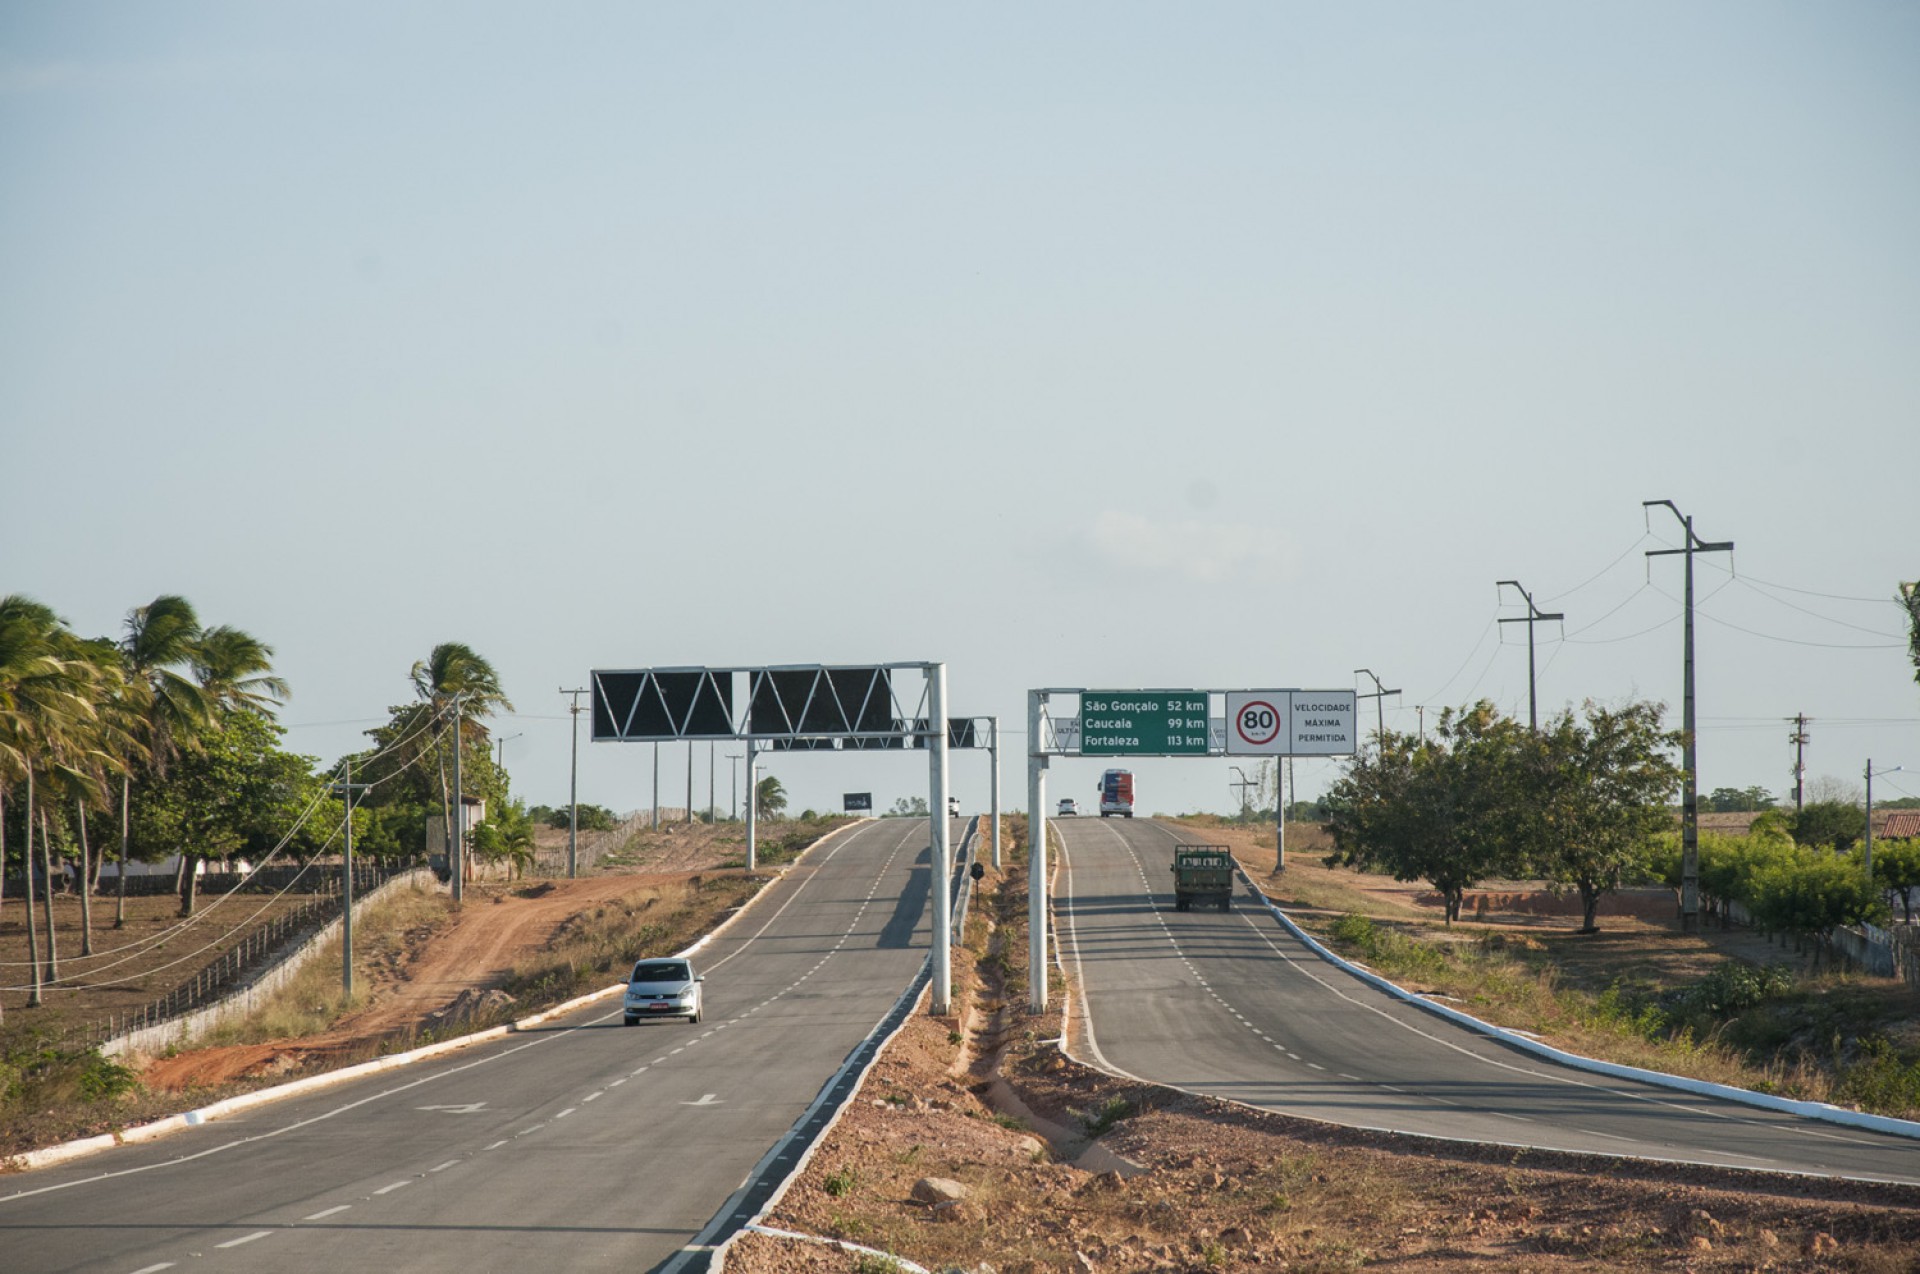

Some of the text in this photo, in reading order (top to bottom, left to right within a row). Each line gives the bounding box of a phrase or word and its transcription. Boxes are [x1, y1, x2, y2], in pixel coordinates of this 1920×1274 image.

[1085, 701, 1204, 714] São Gonçalo 52 km
[1294, 704, 1351, 712] VELOCIDADE
[1085, 718, 1132, 729] Caucaia
[1168, 718, 1182, 729] 99
[1186, 718, 1204, 729] km
[1244, 710, 1273, 729] 80
[1304, 718, 1341, 727] MÁXIMA
[1085, 735, 1204, 746] Fortaleza 113 km
[1298, 734, 1346, 742] PERMITIDA
